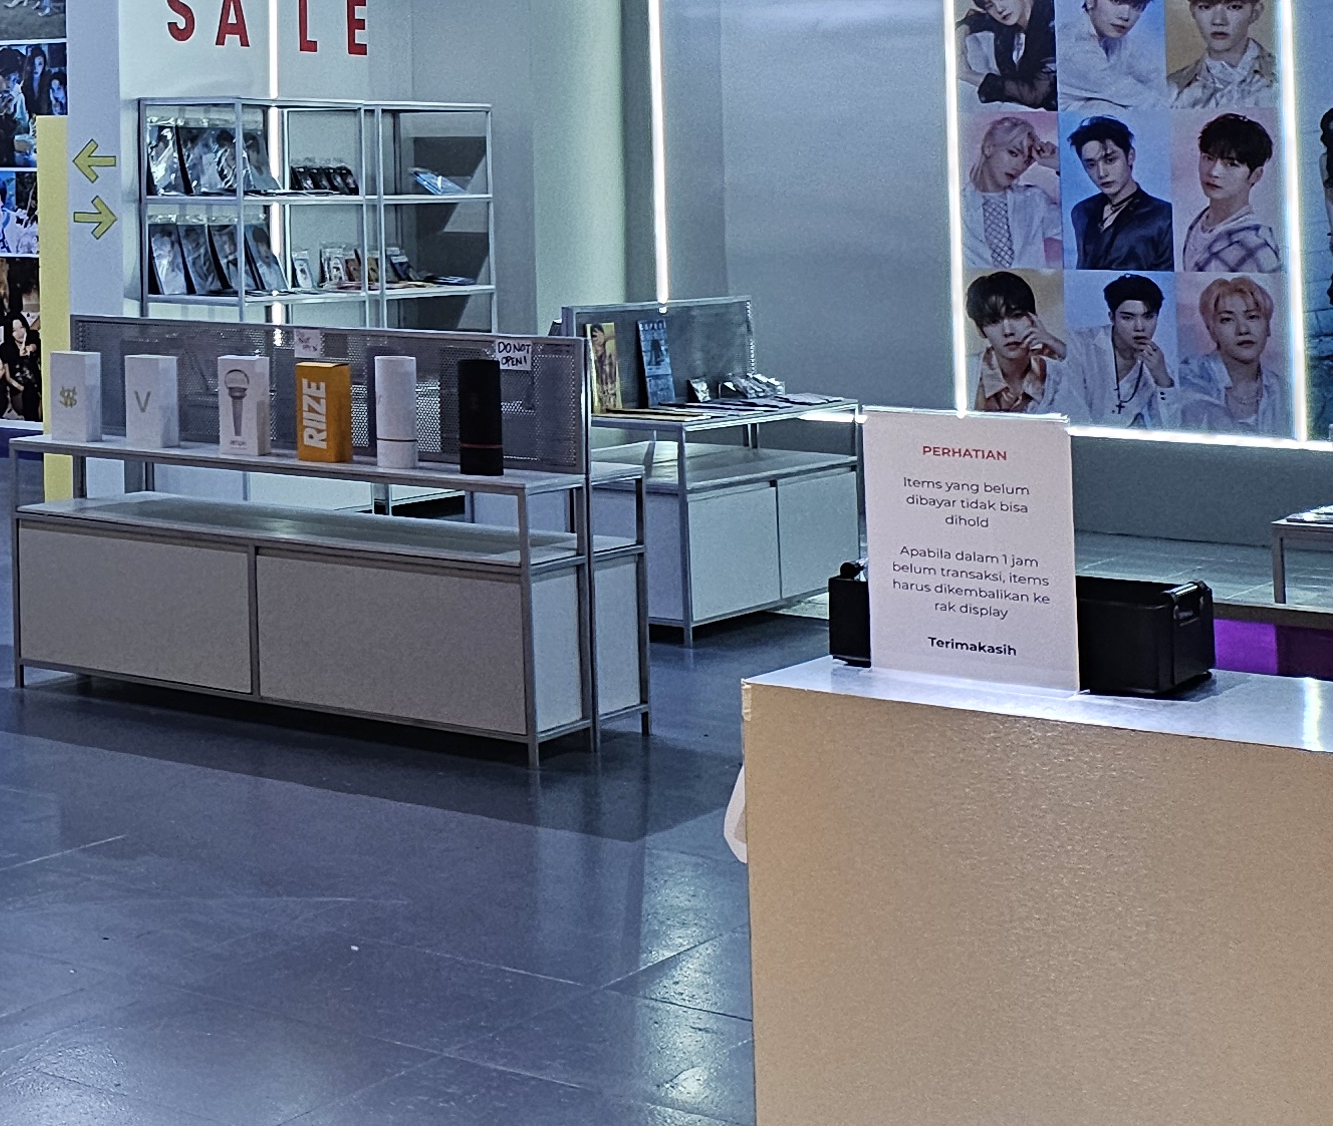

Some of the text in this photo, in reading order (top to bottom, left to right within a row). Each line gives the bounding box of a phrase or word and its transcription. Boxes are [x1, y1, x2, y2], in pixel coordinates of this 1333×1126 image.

[498, 341, 531, 354] DO NOT
[302, 378, 327, 449] RIIZE
[922, 445, 1007, 461] PERHATIAN
[903, 477, 1030, 495] Items yang belum
[906, 494, 1029, 514] dibayar tidak bisa
[945, 514, 989, 528] dihold
[899, 545, 952, 561] Apabila
[955, 549, 999, 564] dalam
[1010, 554, 1039, 569] jam
[892, 561, 1050, 587] belum transaksi, items
[892, 579, 1051, 605] harus dikembalikan ke
[934, 600, 1009, 620] rak display
[928, 636, 1017, 656] Terimakasih
